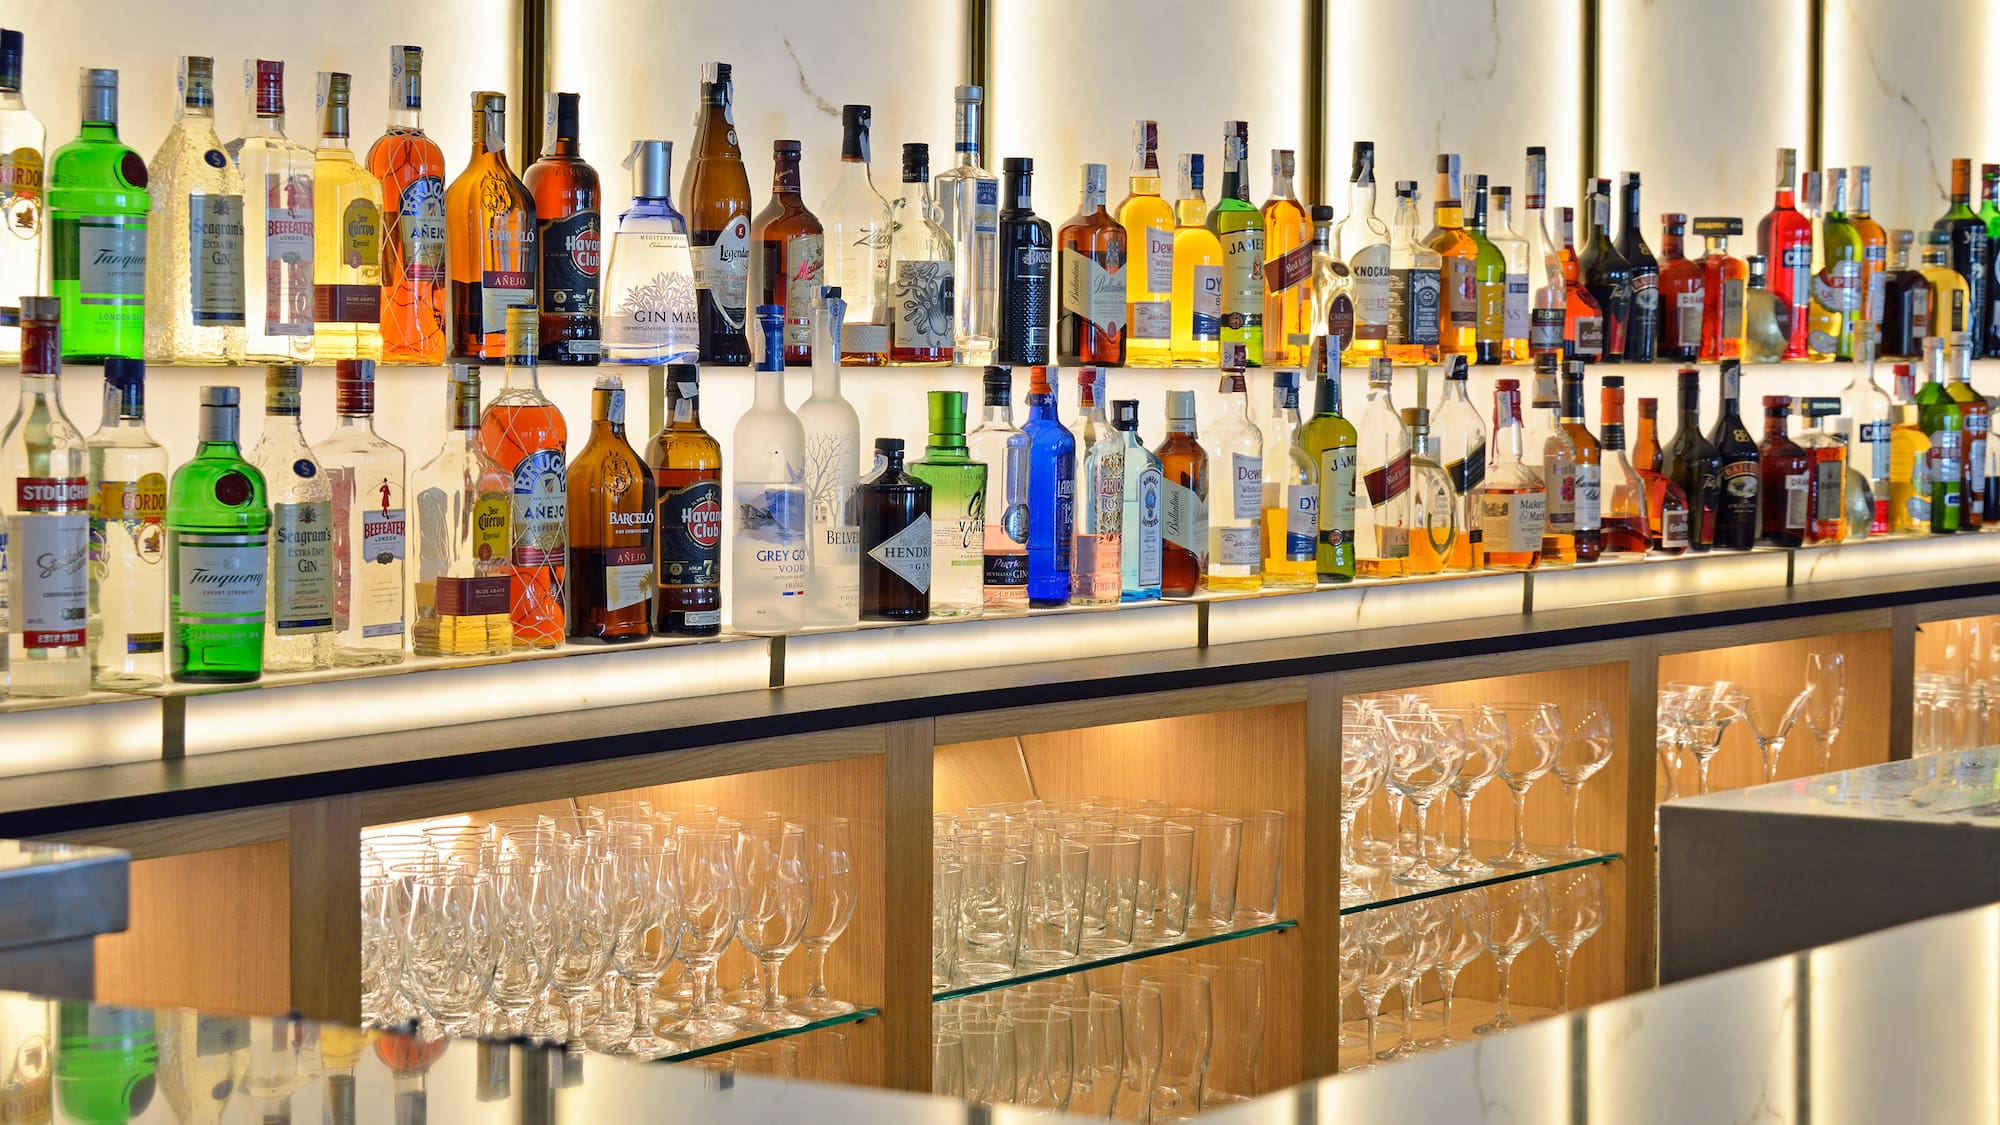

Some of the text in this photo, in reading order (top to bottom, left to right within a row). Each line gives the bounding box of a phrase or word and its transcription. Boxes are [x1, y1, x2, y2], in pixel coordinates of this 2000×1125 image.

[0, 164, 42, 188] ORDO
[193, 218, 244, 237] Seagram's
[268, 219, 314, 238] BEEFEATER
[348, 223, 375, 238] Cuervo
[212, 251, 231, 266] GIN
[577, 252, 600, 267] Club
[719, 244, 749, 262] Legenda
[877, 259, 888, 268] 23
[494, 275, 527, 287] AÑEJO
[586, 288, 596, 305] 7
[634, 310, 667, 323] GIN
[1507, 310, 1521, 320] VS
[525, 501, 565, 519] AÑEJO
[1299, 496, 1319, 510] DY
[488, 506, 500, 516] Jose
[609, 509, 655, 526] BARCELÓ
[1167, 490, 1180, 536] Ballantine's
[478, 513, 505, 530] Cuervo
[278, 526, 332, 546] Seagram's
[364, 520, 406, 540] BEEFEATER
[693, 525, 719, 539] Club
[288, 547, 325, 557] EXTRA DRY
[617, 551, 647, 563] AÑEJO
[756, 550, 790, 562] GREY
[297, 558, 317, 573] GIN
[703, 559, 713, 577] 7
[190, 567, 264, 588] Tanqueray
[1012, 569, 1028, 579] GIN
